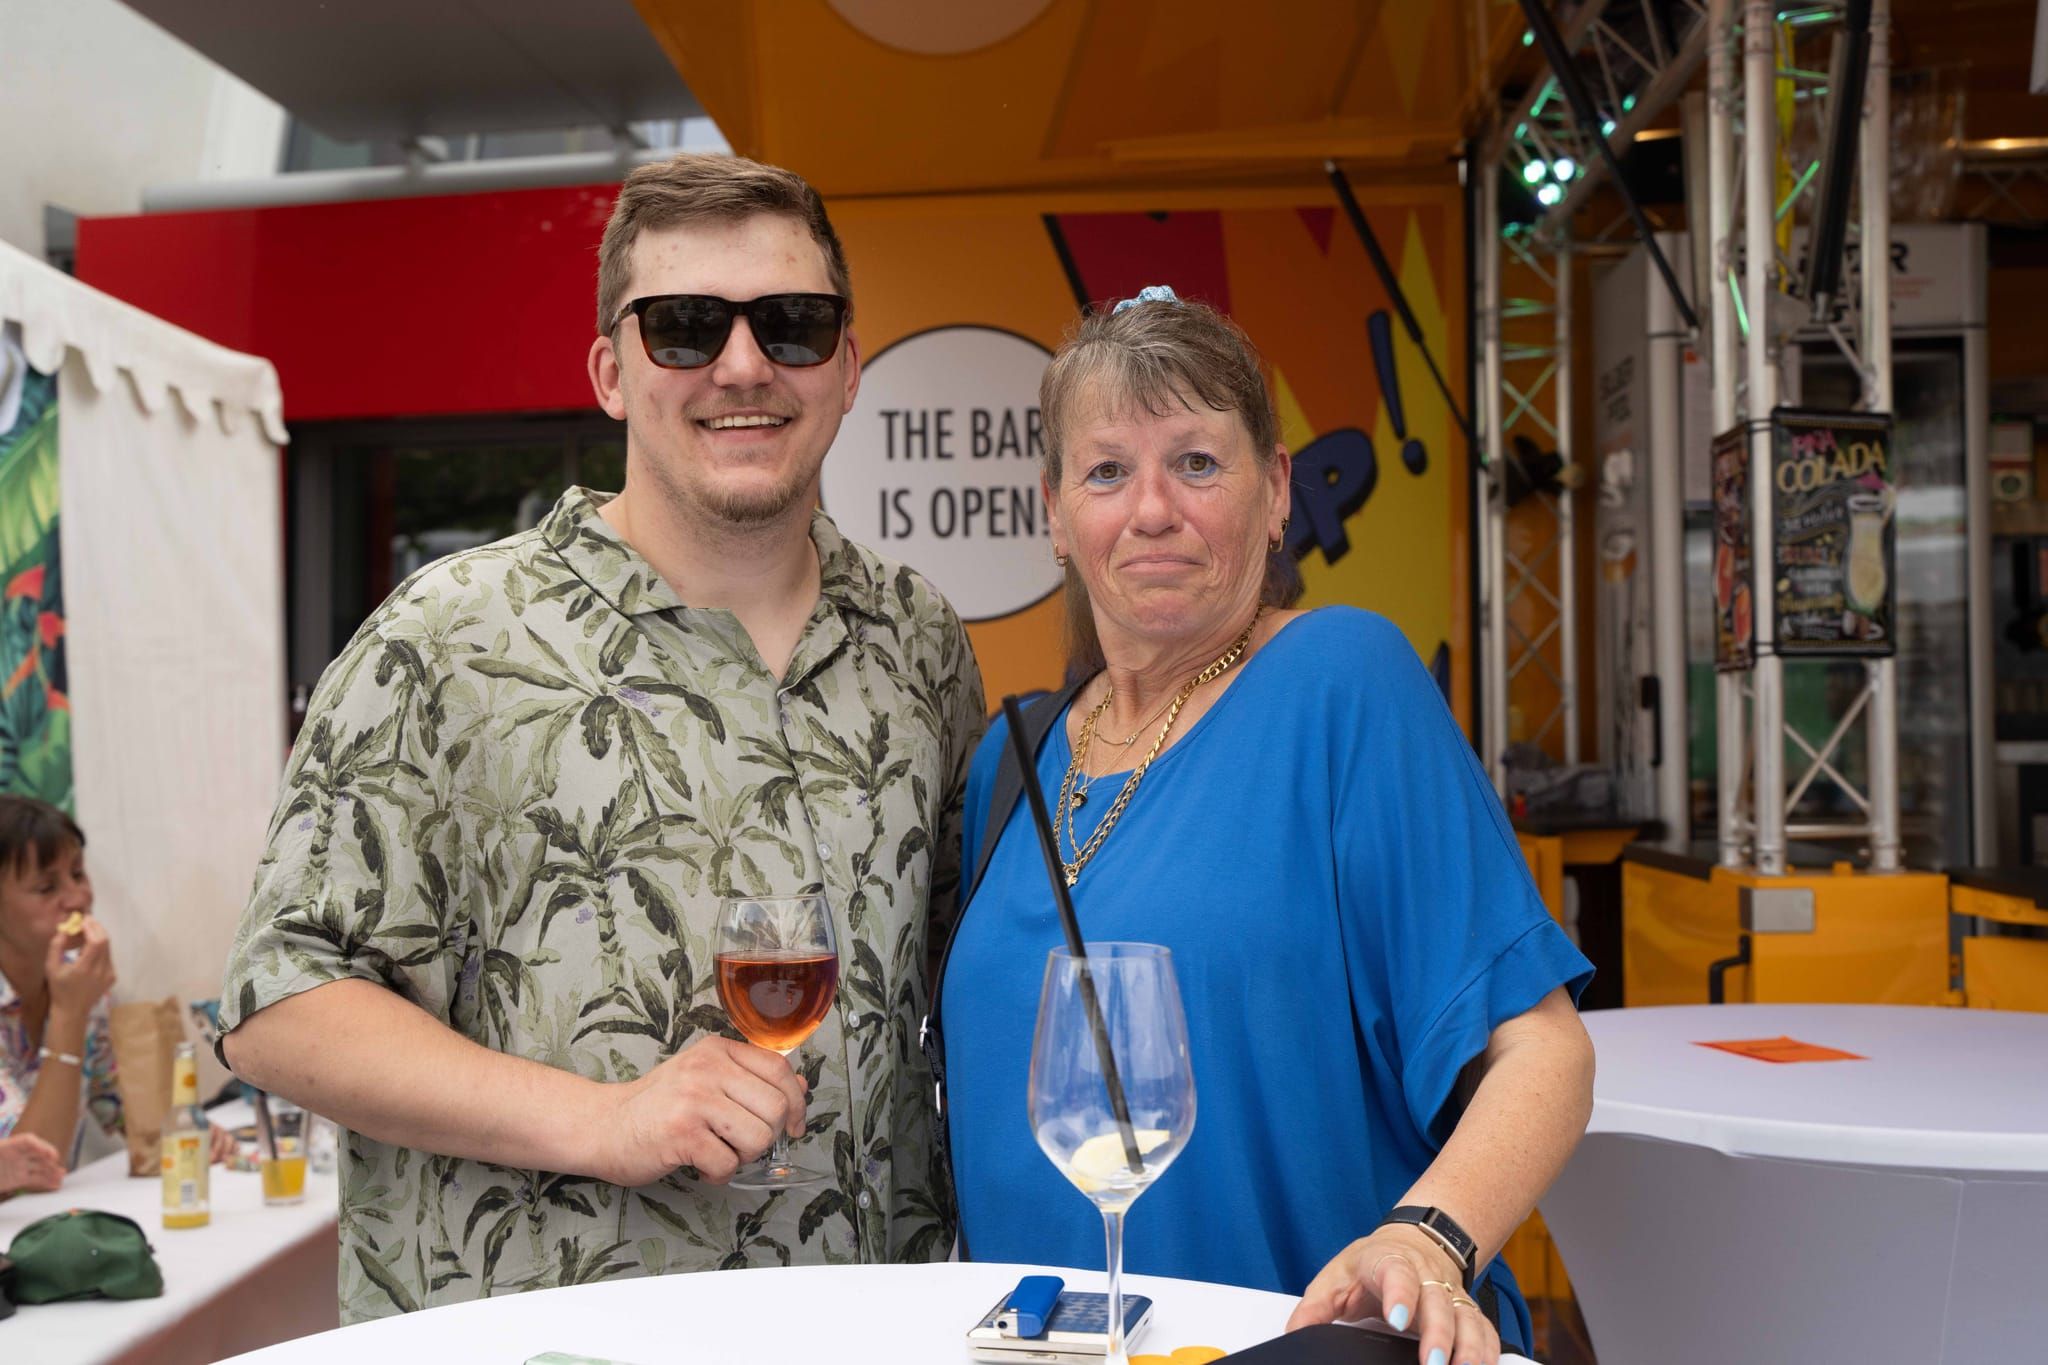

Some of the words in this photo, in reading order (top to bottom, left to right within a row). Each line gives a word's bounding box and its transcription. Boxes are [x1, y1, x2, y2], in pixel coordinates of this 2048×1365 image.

[880, 410, 954, 460] THE
[971, 408, 1044, 460] BAR
[1777, 440, 1887, 493] COLADA
[879, 488, 914, 540] IS
